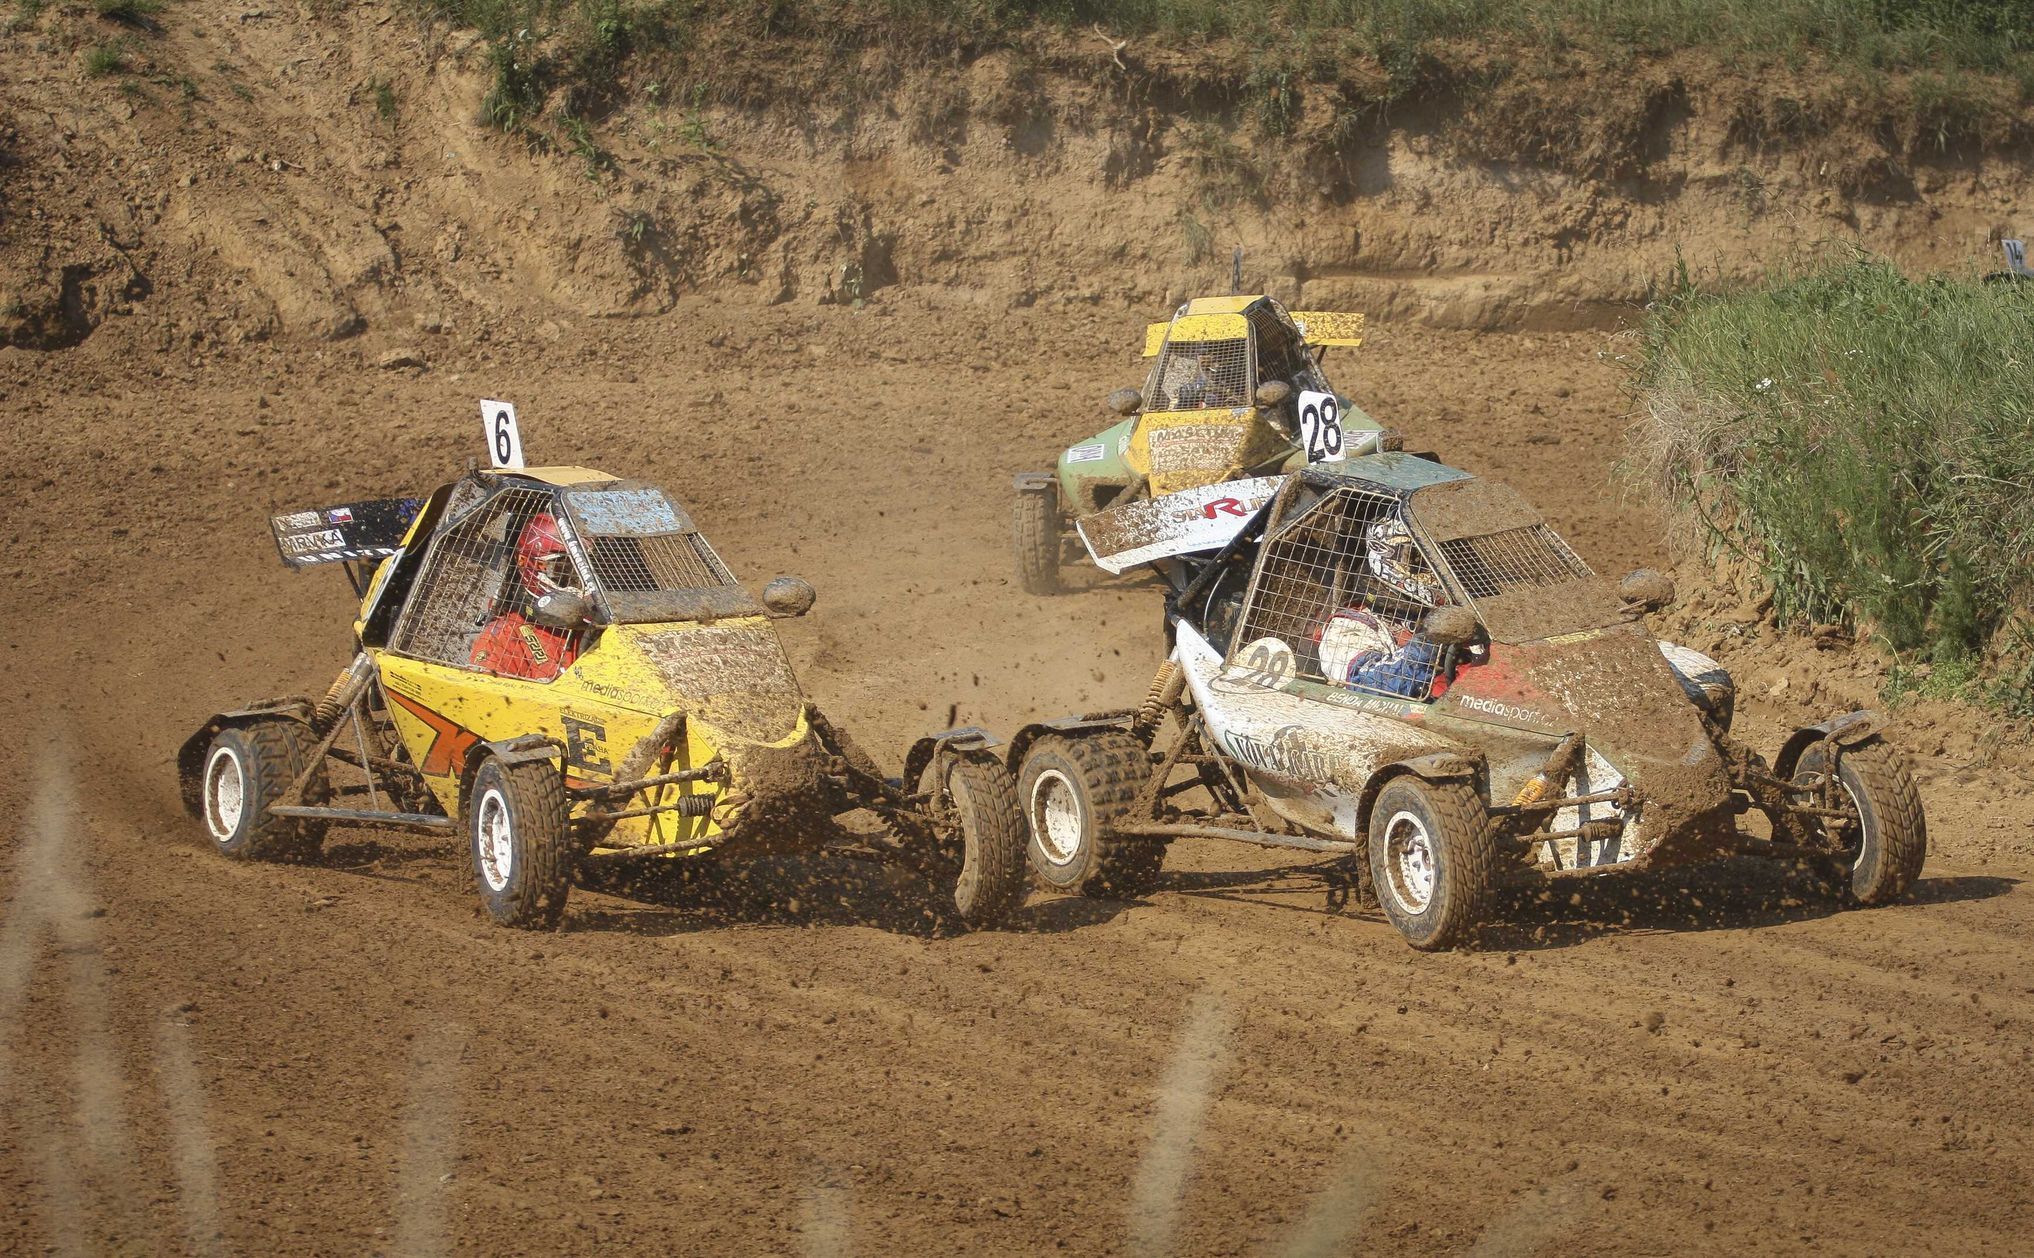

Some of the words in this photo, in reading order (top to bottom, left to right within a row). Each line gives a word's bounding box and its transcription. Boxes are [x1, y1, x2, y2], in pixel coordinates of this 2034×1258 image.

[495, 410, 511, 465] 6
[1302, 397, 1342, 464] 28
[1229, 645, 1289, 690] 28
[1326, 691, 1361, 707] BENDA
